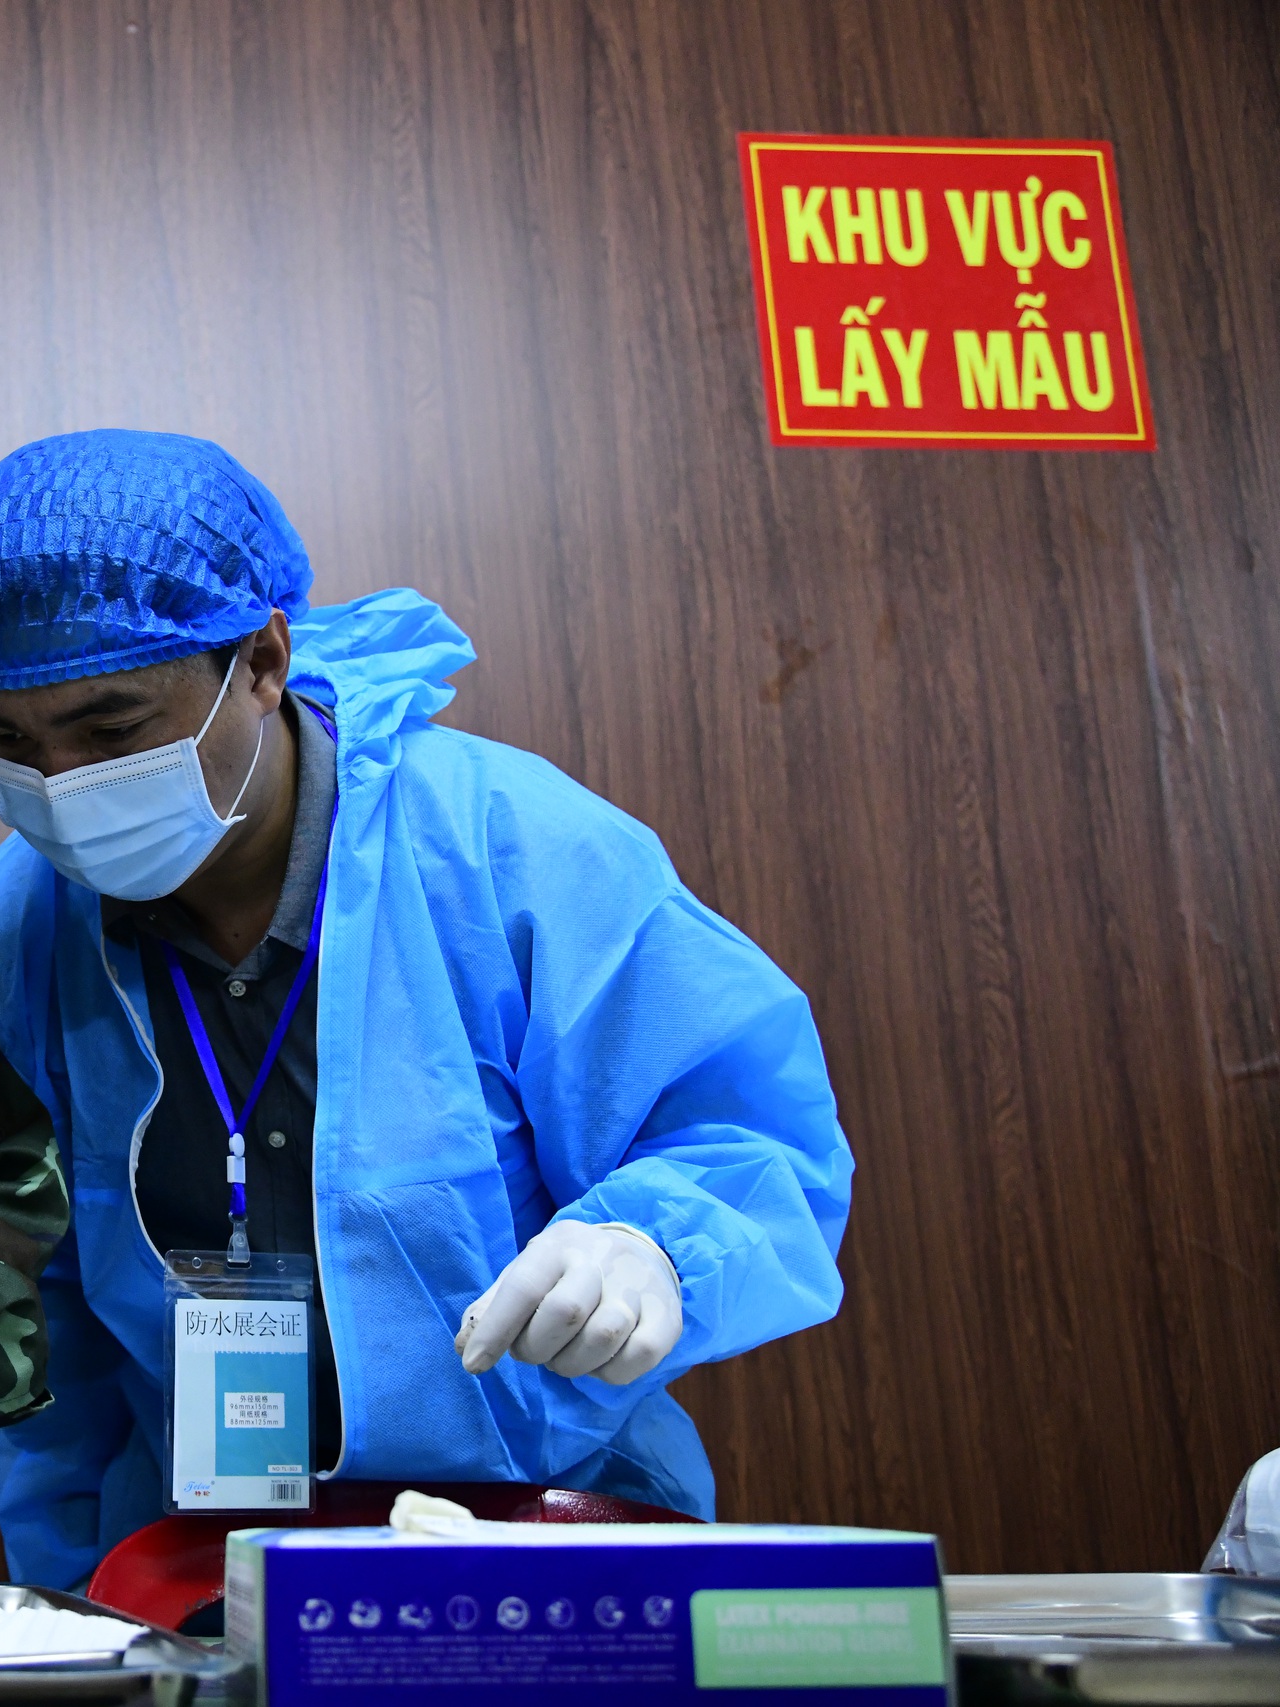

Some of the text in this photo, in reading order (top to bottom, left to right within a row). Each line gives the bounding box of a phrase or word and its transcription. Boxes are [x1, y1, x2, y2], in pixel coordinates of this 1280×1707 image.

[782, 176, 1091, 284] KHU VỰC
[794, 292, 1114, 412] LẤY MẪU
[186, 1310, 302, 1337] 防水展会证
